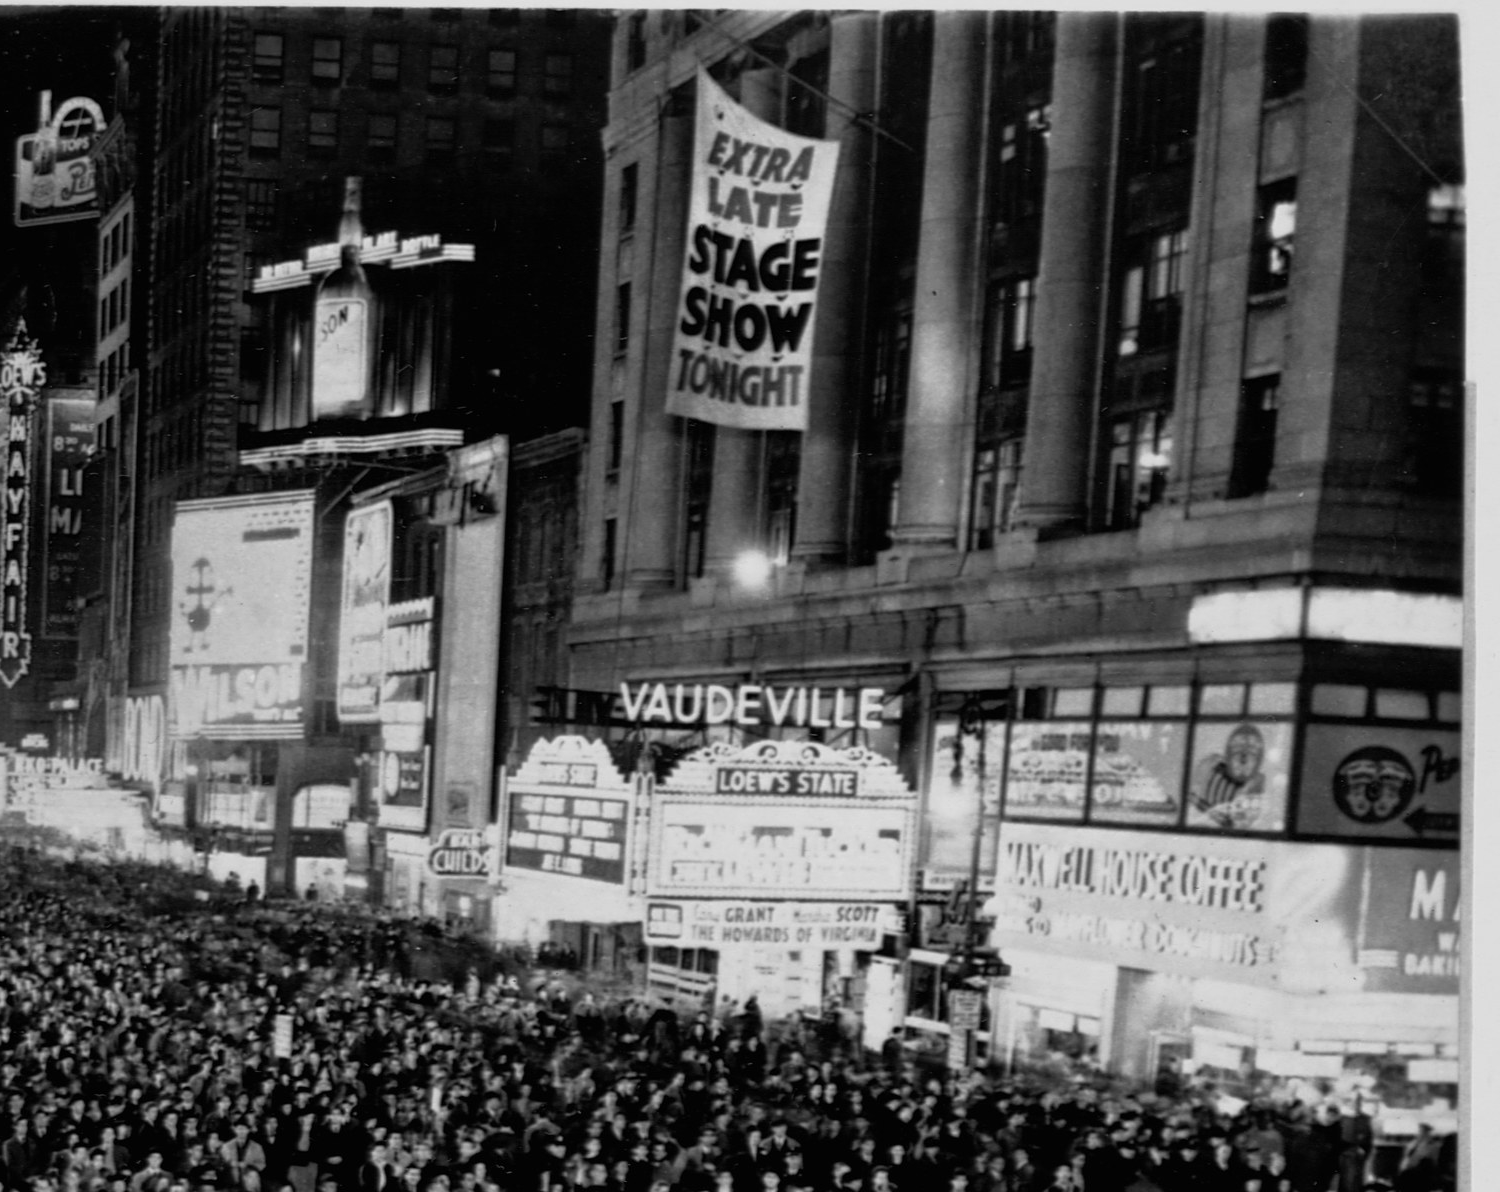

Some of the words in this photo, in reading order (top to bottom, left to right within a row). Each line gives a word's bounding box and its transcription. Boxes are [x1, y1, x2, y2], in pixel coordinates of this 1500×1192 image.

[708, 131, 816, 183] EXTRA
[708, 177, 804, 229] LATE
[690, 224, 821, 293] STAGE
[680, 286, 815, 353] SHOW
[677, 349, 804, 408] TONIGHT
[3, 414, 26, 659] MAYFAIR
[619, 681, 885, 729] VAUDEVILLE
[718, 770, 791, 793] LOEW'S
[797, 772, 857, 795] STATE
[433, 849, 491, 873] CHILDS
[1007, 842, 1096, 894] MAXWELL
[1102, 849, 1176, 902] HOUSE
[1180, 854, 1268, 913] COFFEE
[690, 924, 715, 942] THE
[721, 926, 790, 943] HOWARDS
[796, 926, 813, 943] OF
[821, 926, 877, 943] VIRGINIA
[725, 906, 775, 923] GRANT
[836, 905, 880, 923] SCOTT
